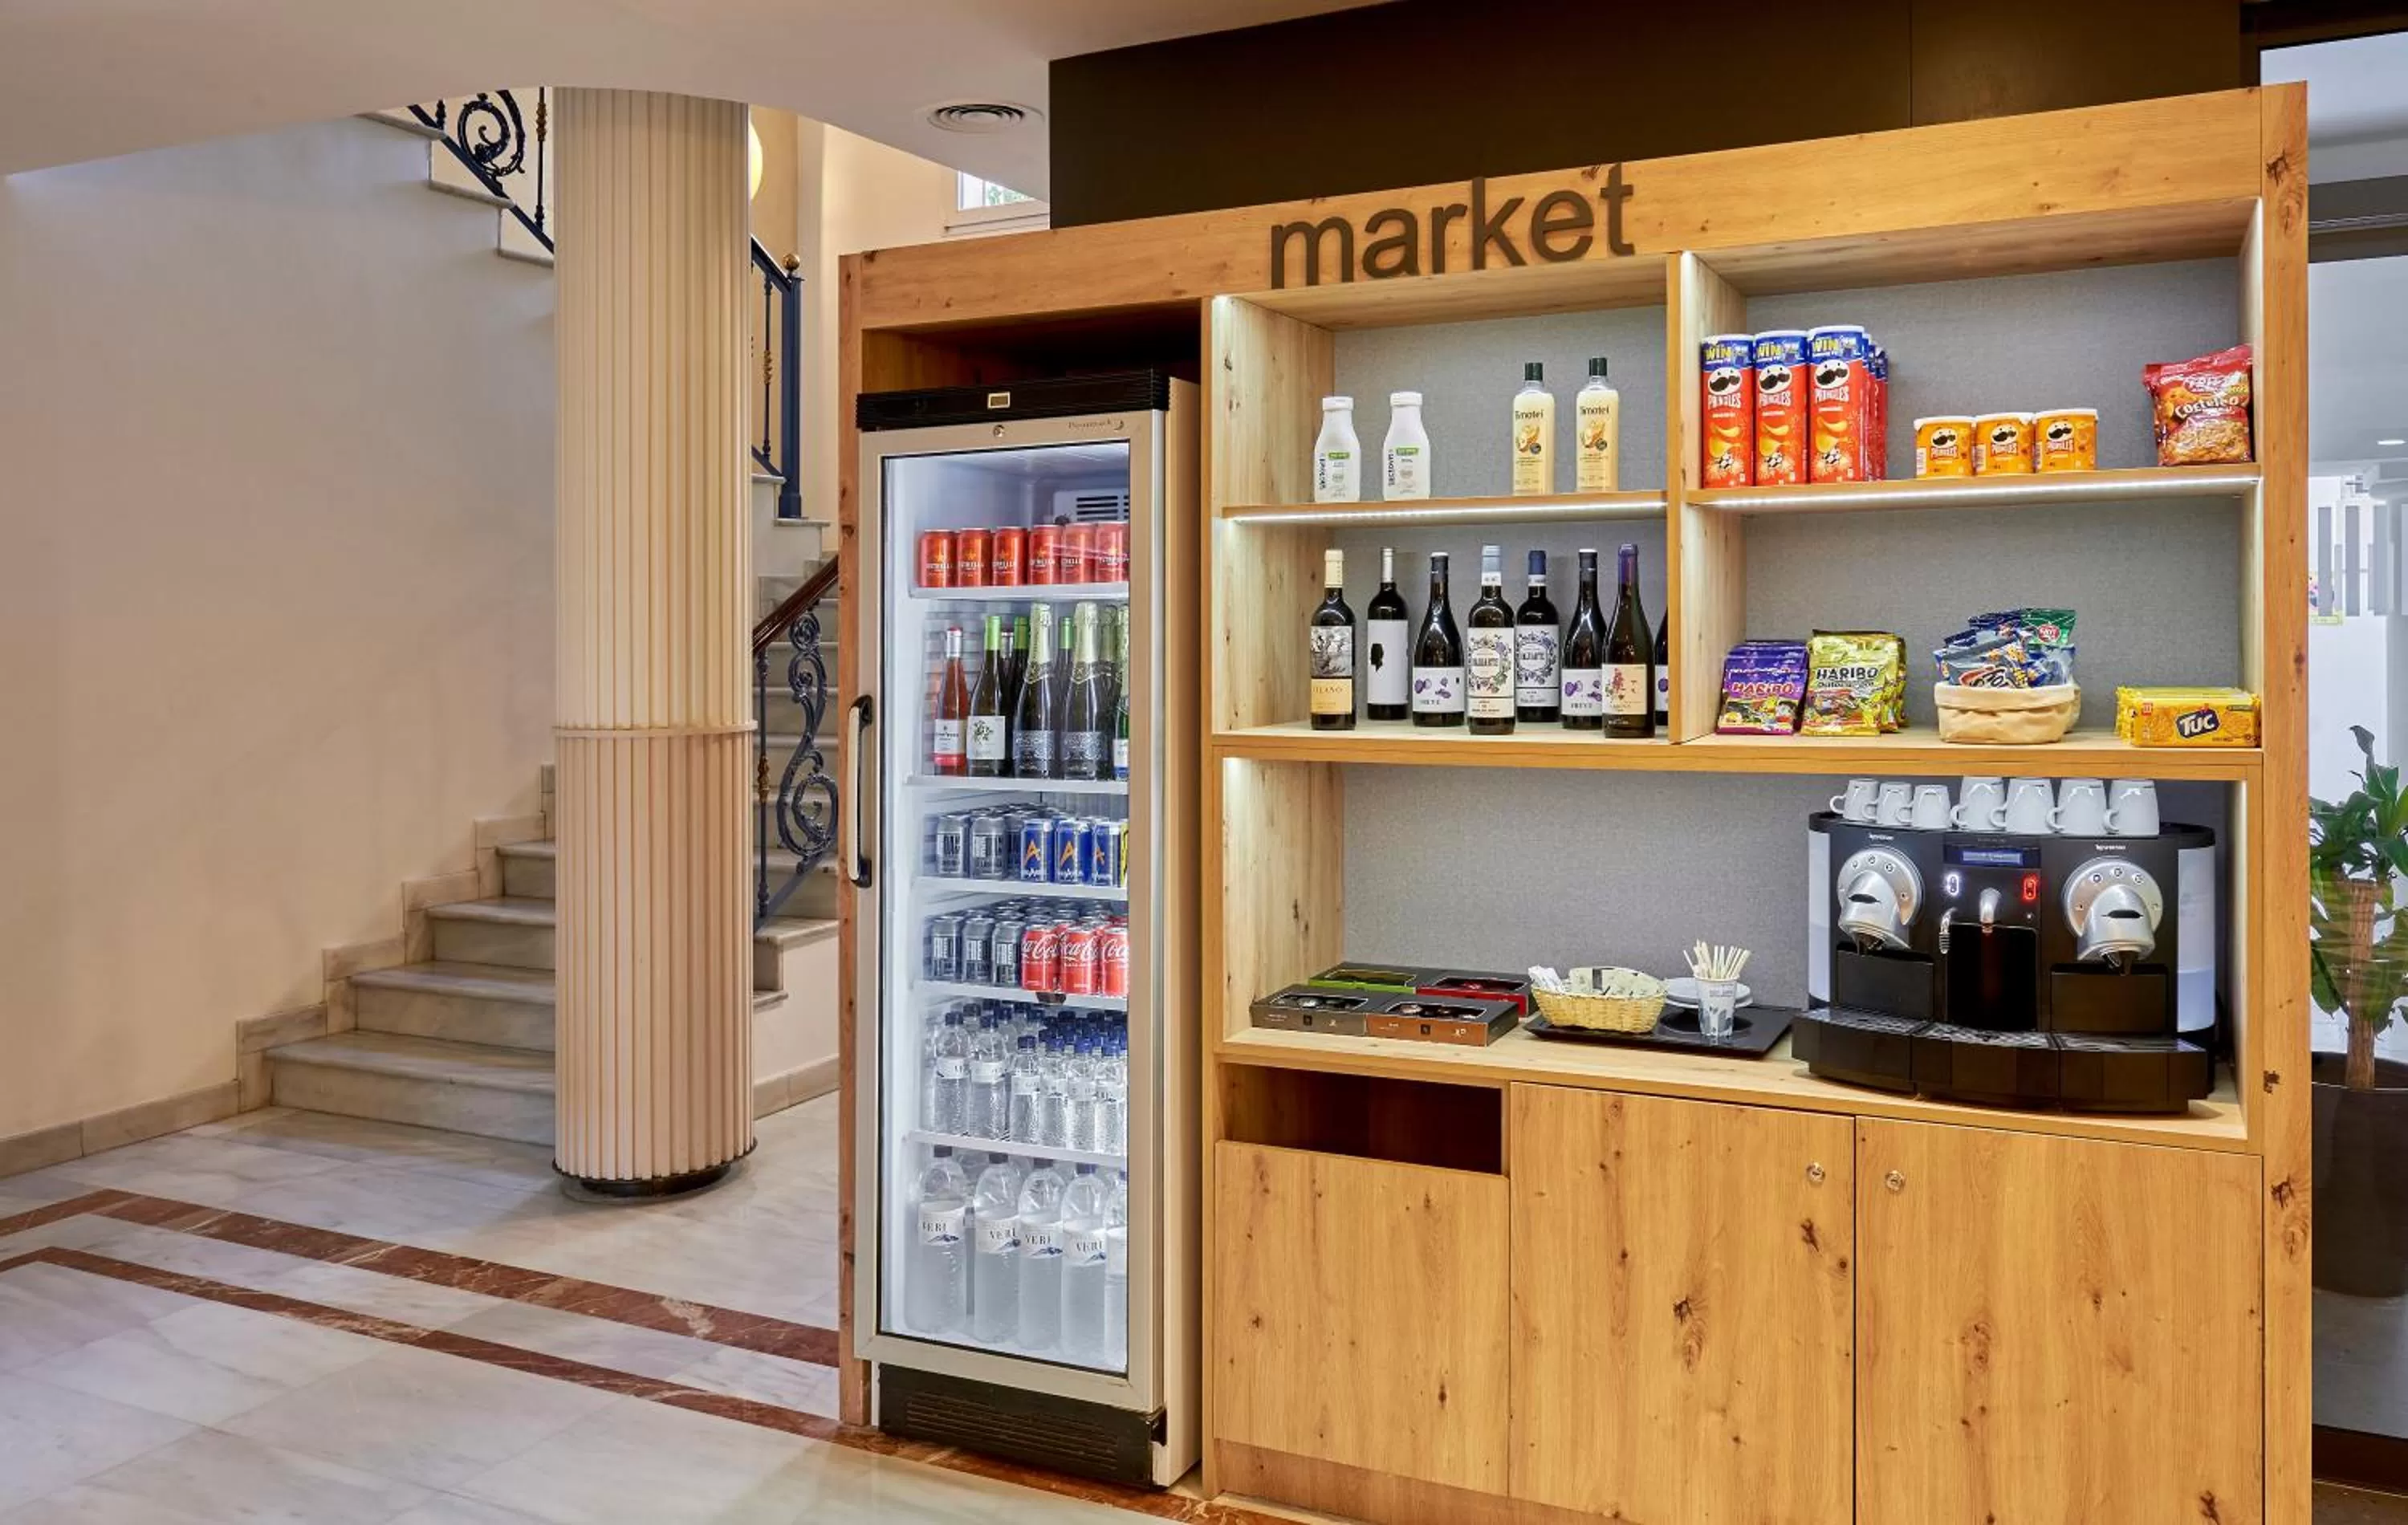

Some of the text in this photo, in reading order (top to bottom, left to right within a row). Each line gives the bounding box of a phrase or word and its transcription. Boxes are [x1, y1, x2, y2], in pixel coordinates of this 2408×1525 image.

[1271, 162, 1635, 289] market
[1816, 667, 1878, 680] HARIBO
[2179, 714, 2215, 736] TUC
